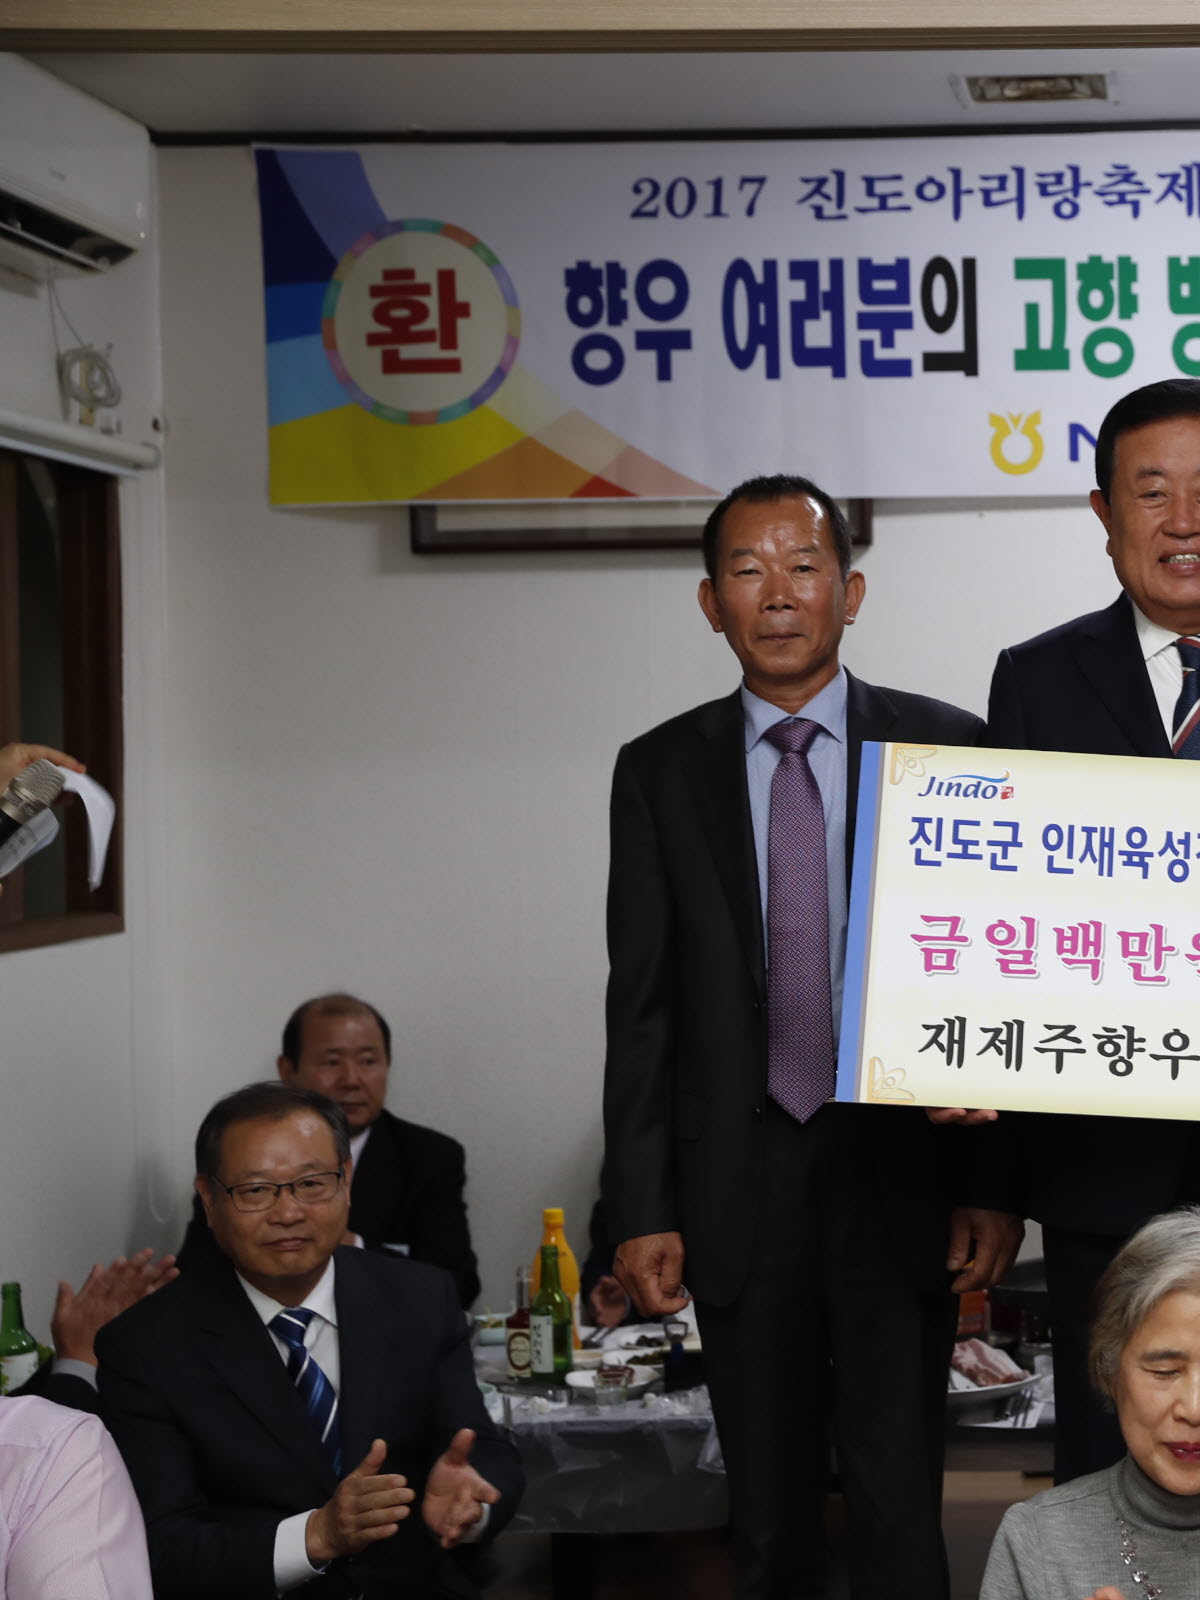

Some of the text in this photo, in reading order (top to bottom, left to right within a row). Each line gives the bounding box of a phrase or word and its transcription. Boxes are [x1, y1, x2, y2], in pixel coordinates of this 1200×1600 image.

[629, 176, 768, 220] 2017
[365, 267, 471, 375] 환
[563, 258, 694, 386] 향우
[719, 254, 981, 381] 여러분의
[1011, 253, 1141, 379] 고향
[917, 775, 999, 800] Jindo
[908, 816, 1024, 872] 진도군
